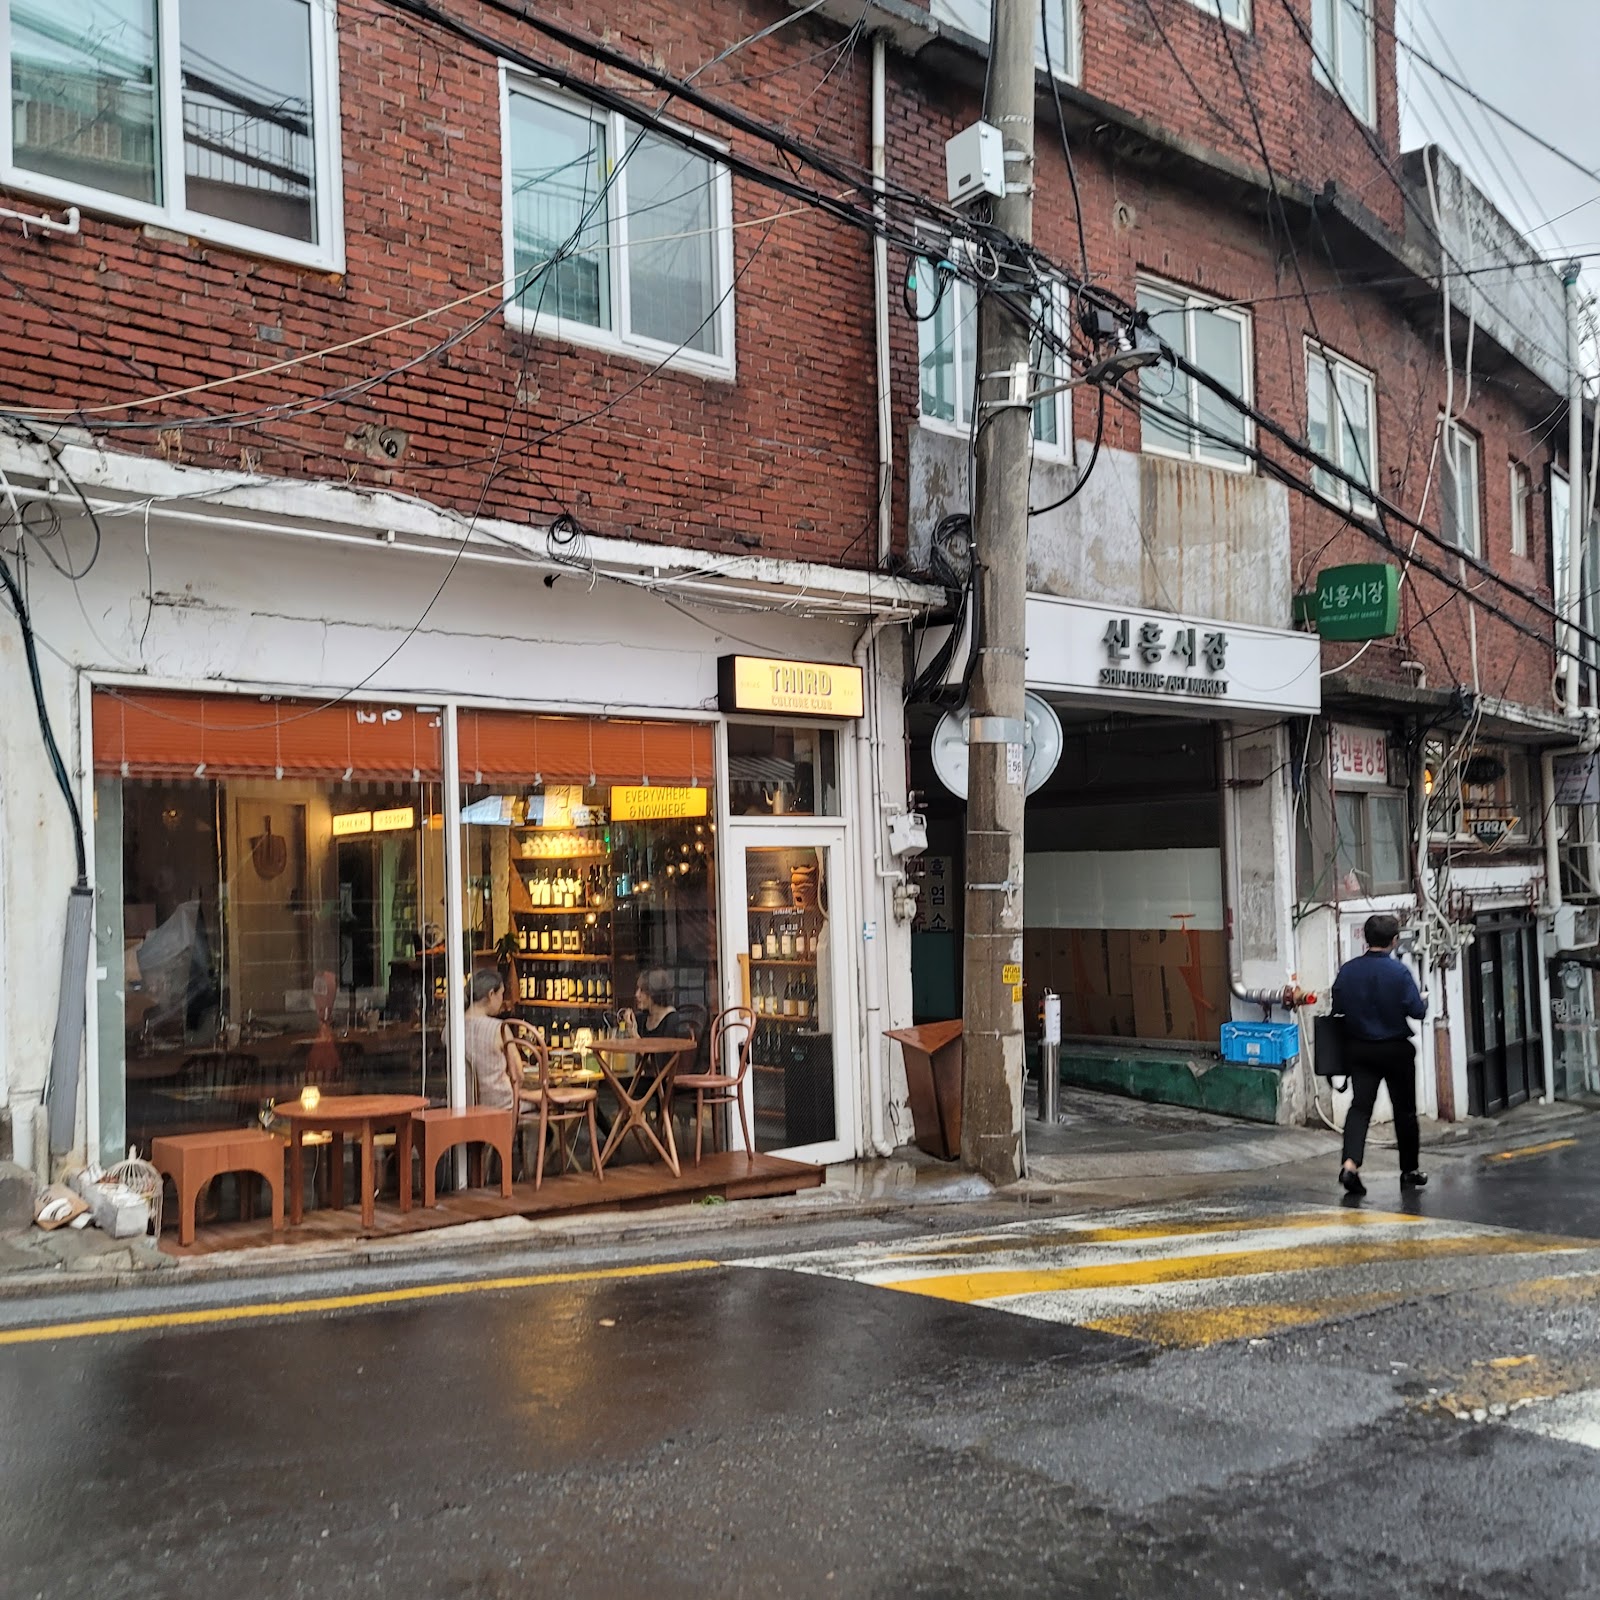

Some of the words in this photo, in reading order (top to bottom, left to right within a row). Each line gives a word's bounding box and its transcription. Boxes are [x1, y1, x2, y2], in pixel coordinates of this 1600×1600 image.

[1319, 580, 1384, 609] 신흥시장
[1102, 619, 1228, 671] 신흥시장
[769, 665, 832, 696] THIRD
[1165, 675, 1187, 691] ART
[1188, 678, 1230, 694] MARKET
[771, 695, 809, 709] CULTURE
[810, 698, 833, 711] CLUB
[625, 787, 691, 803] EVERYWHERE
[629, 806, 637, 818] &
[638, 803, 687, 817] NOWHERE
[1470, 820, 1509, 834] TERRA
[930, 858, 948, 932] 흑염소
